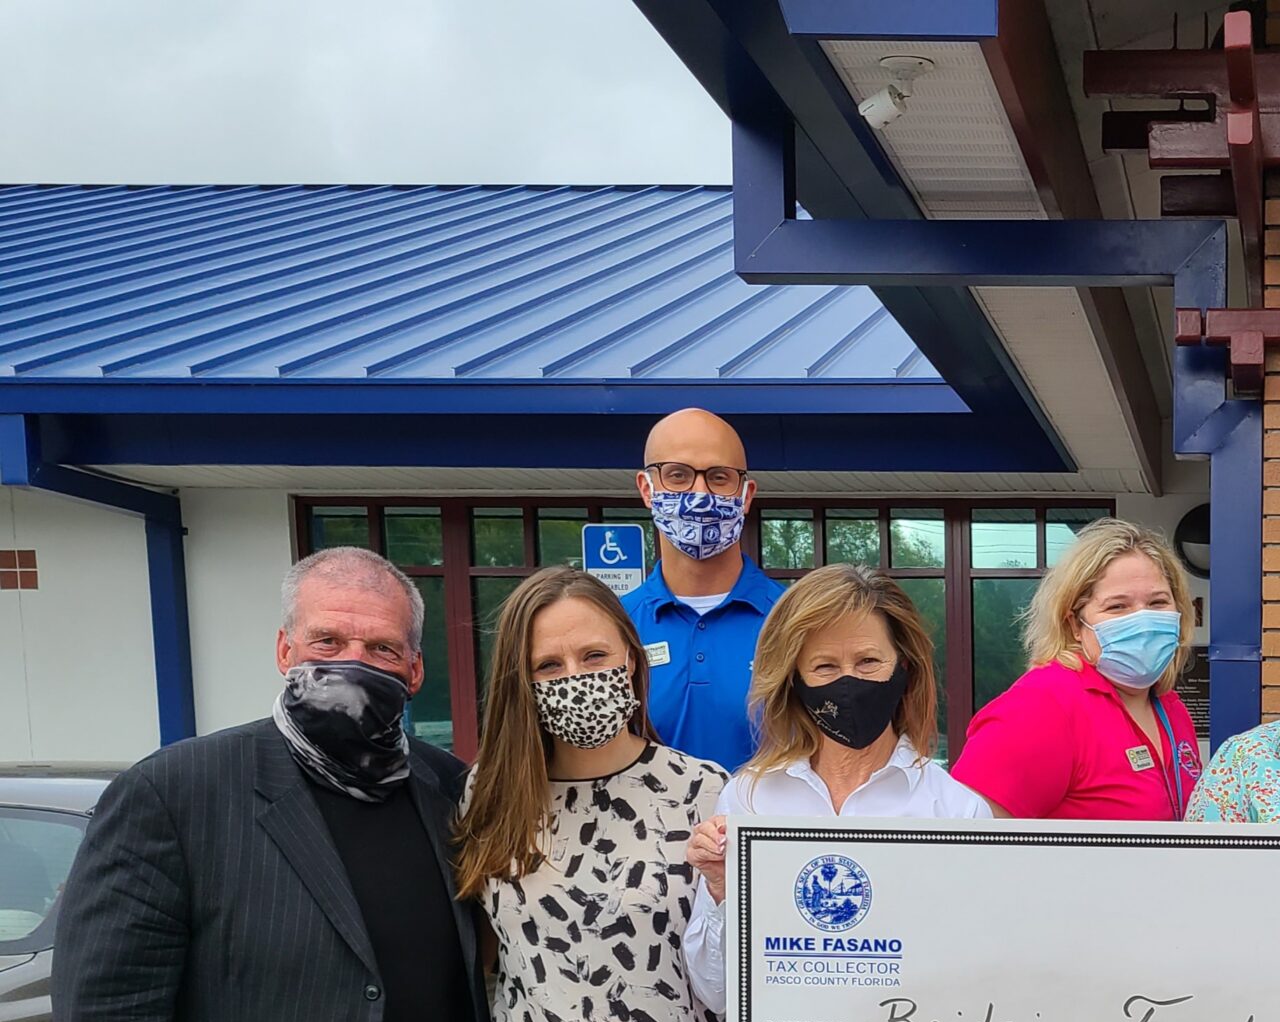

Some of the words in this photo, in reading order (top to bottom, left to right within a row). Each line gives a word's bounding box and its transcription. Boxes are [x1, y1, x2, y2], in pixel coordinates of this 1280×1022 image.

[765, 937, 816, 951] MIKE
[822, 938, 902, 952] FASANO
[766, 960, 798, 973] TAX
[803, 961, 900, 975] COLLECTOR
[766, 976, 801, 985] PASCO
[804, 976, 848, 986] COUNTY
[851, 977, 901, 987] FLORIDA
